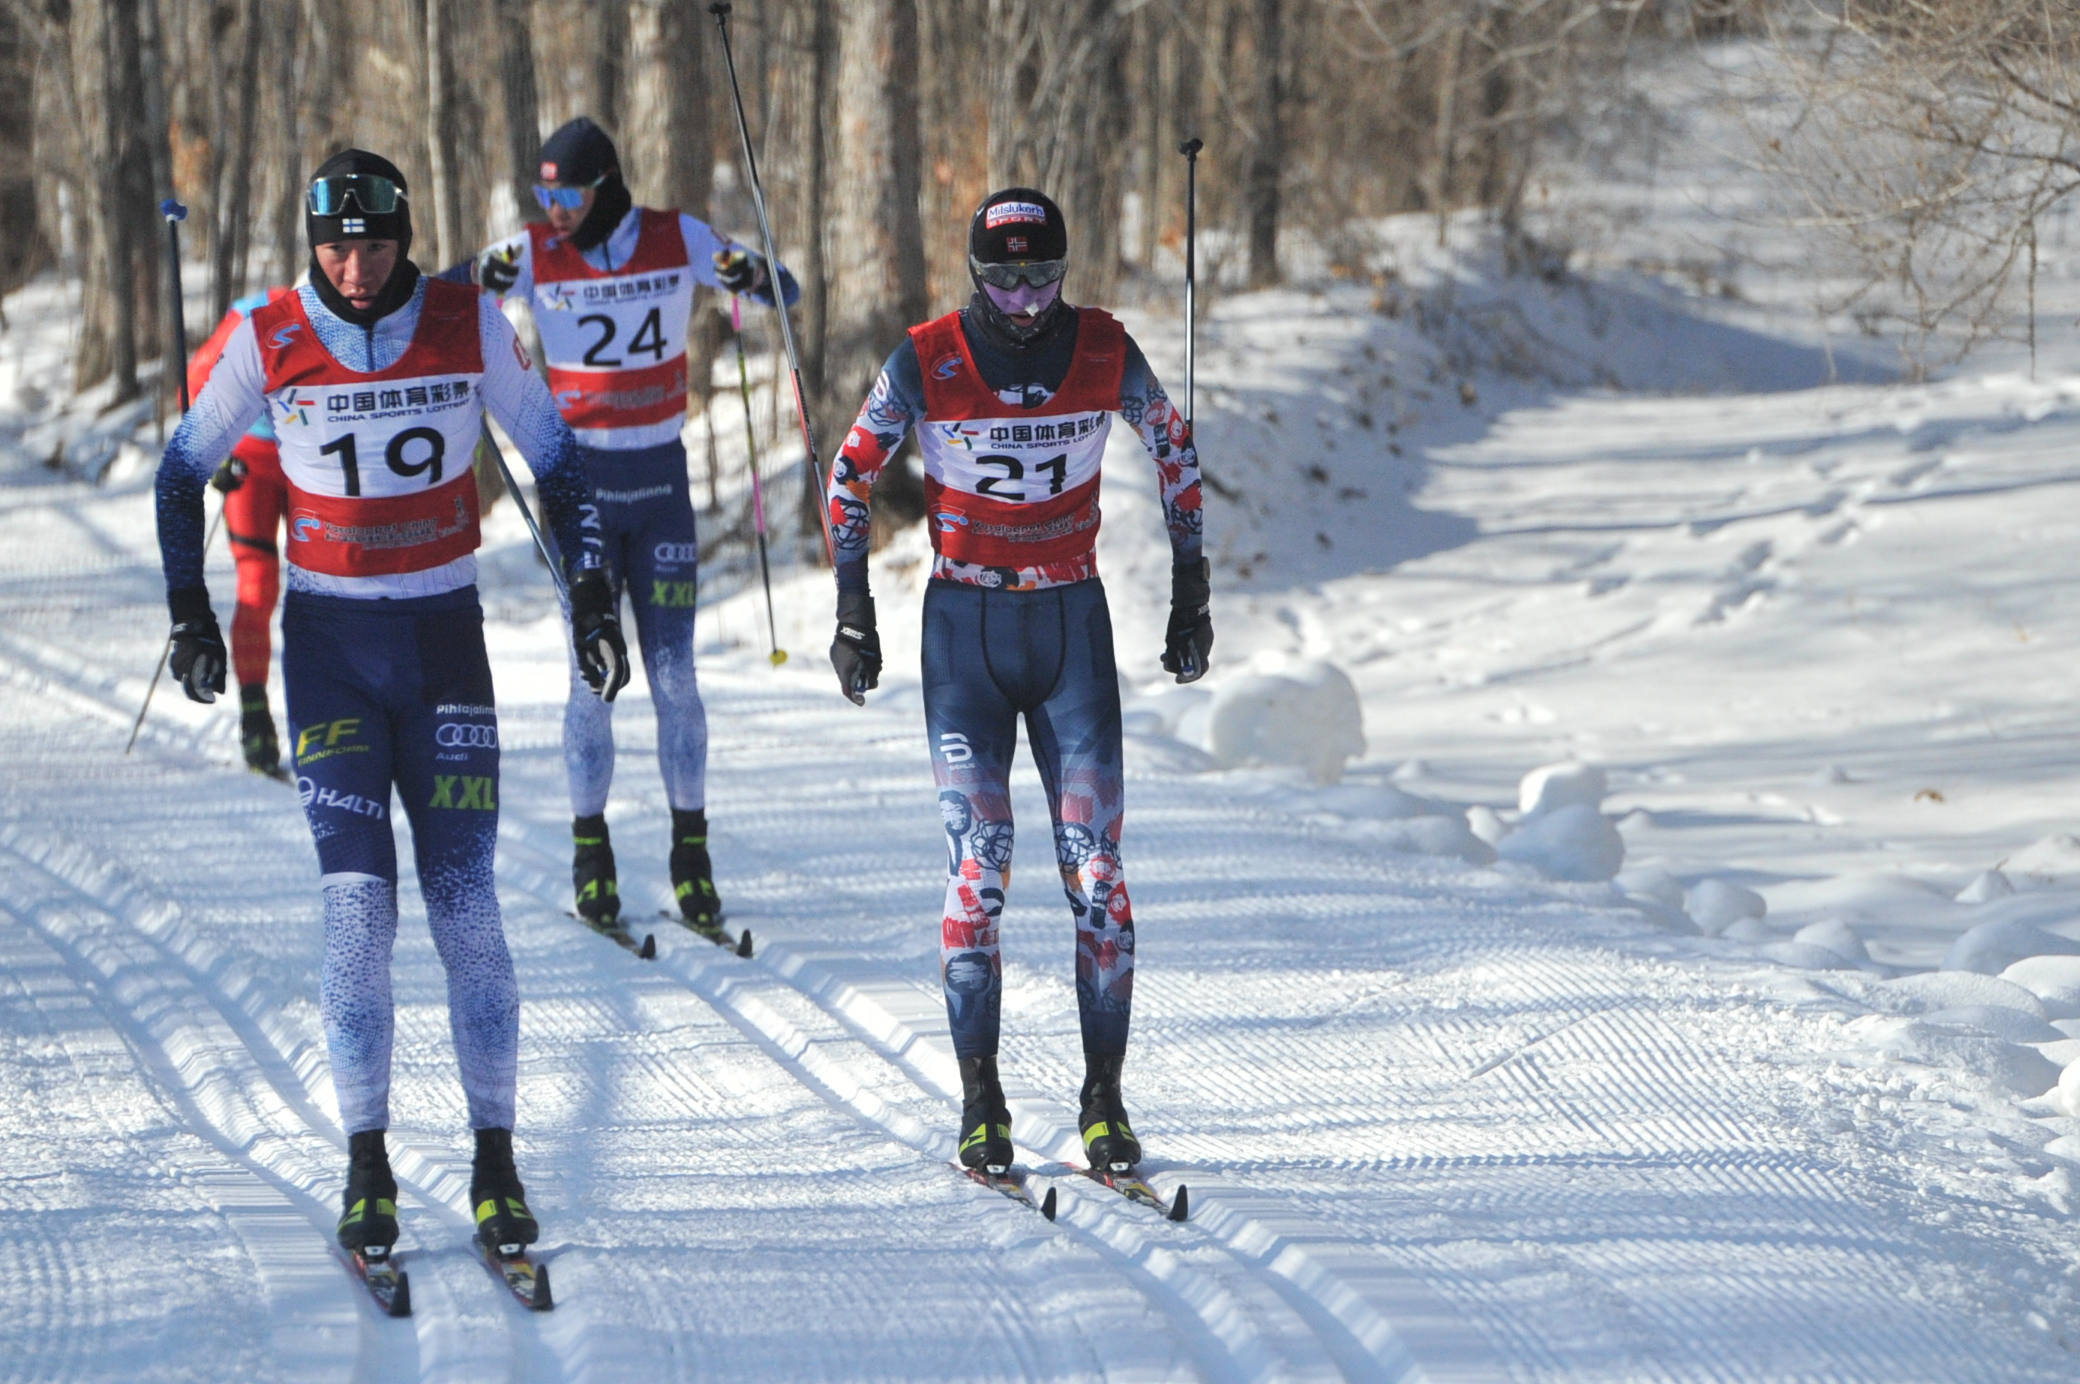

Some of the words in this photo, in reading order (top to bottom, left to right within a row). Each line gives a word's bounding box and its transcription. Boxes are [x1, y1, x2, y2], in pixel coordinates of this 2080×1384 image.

[577, 306, 668, 367] 24
[327, 380, 469, 413] 中国体育彩票
[327, 414, 366, 423] CHINA
[369, 408, 422, 420] SPORTS
[426, 398, 470, 413] LOTTERY
[991, 442, 1023, 450] CHINA
[1027, 439, 1070, 449] SPORTS
[1073, 430, 1097, 443] LOTT
[319, 426, 445, 497] 19
[975, 453, 1067, 501] 21
[324, 522, 397, 535] Vasaloppet
[401, 517, 438, 531] China
[578, 504, 604, 569] FIN
[972, 519, 1041, 533] Vasaloppet
[436, 703, 496, 717] Pihlajalinn
[296, 717, 362, 757] FF
[436, 752, 469, 761] Audi
[317, 787, 386, 820] HALTI
[428, 774, 496, 810] XXL
